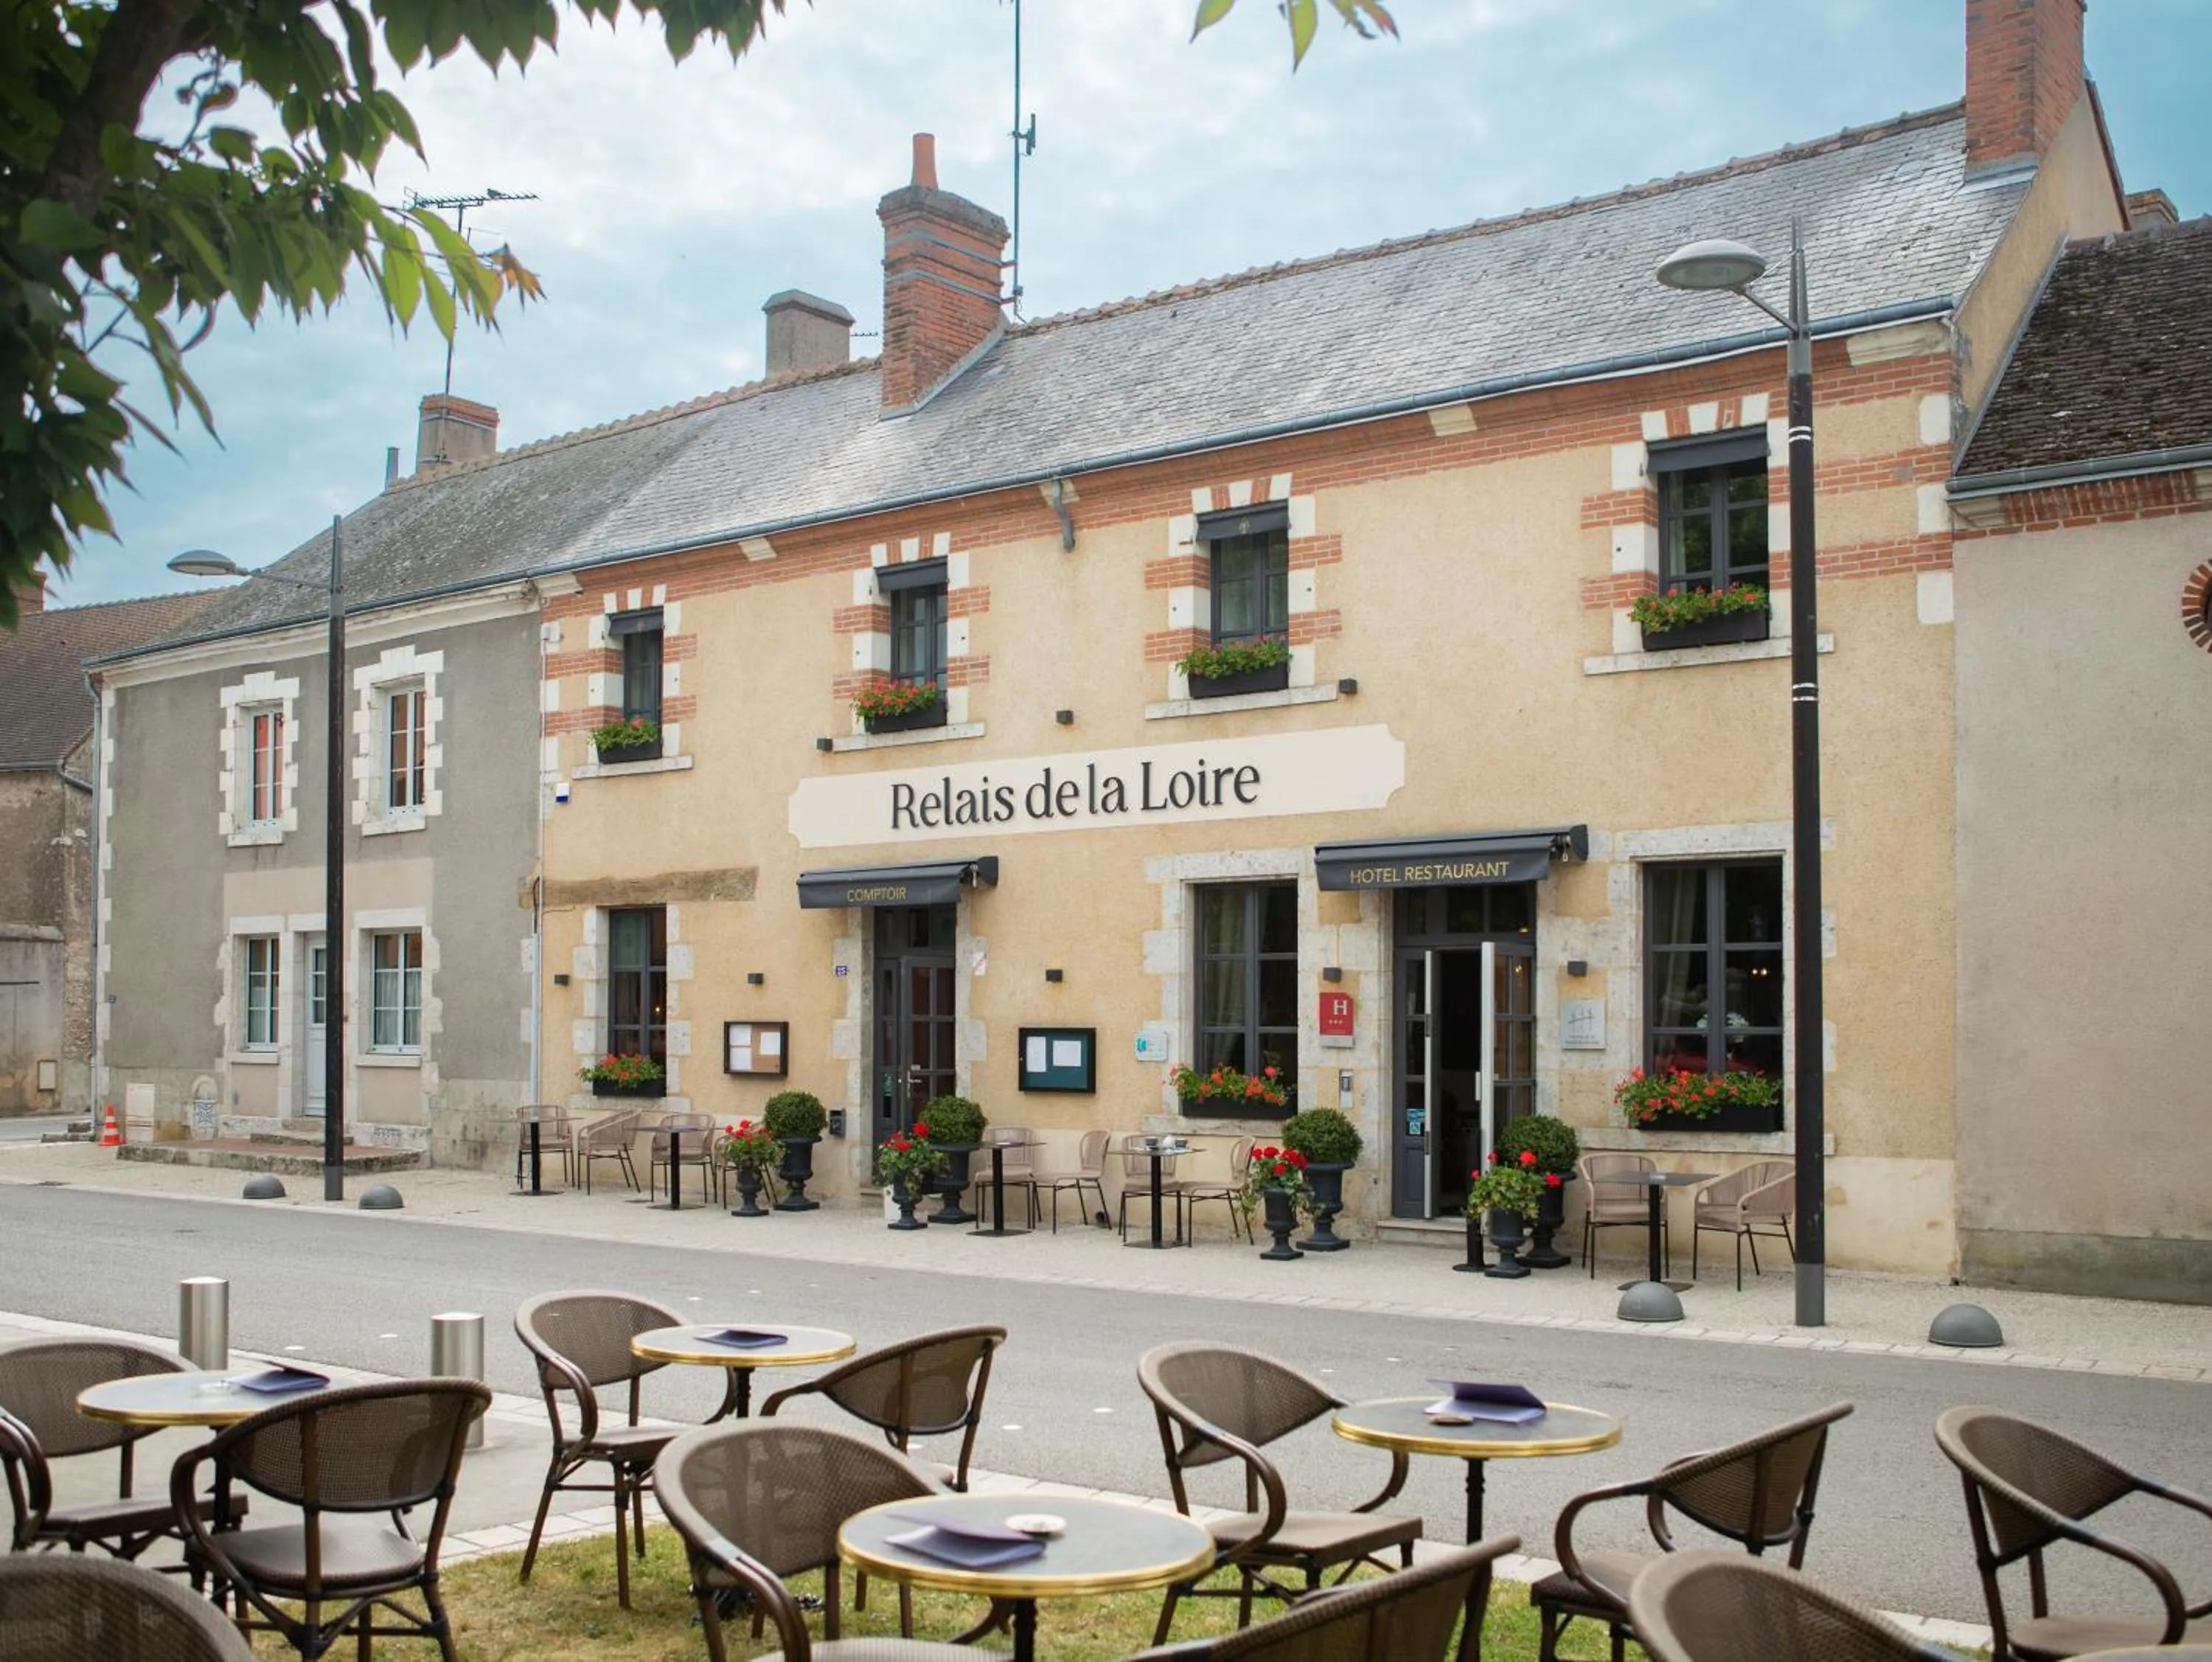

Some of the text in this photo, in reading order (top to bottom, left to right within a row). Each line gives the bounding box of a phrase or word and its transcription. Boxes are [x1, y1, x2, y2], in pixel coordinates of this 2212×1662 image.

[891, 759, 1260, 829] Relais de la Loire
[1350, 861, 1509, 883] HOTEL RESTAURANT
[847, 887, 906, 902] COMPTOIR
[1333, 999, 1347, 1015] H
